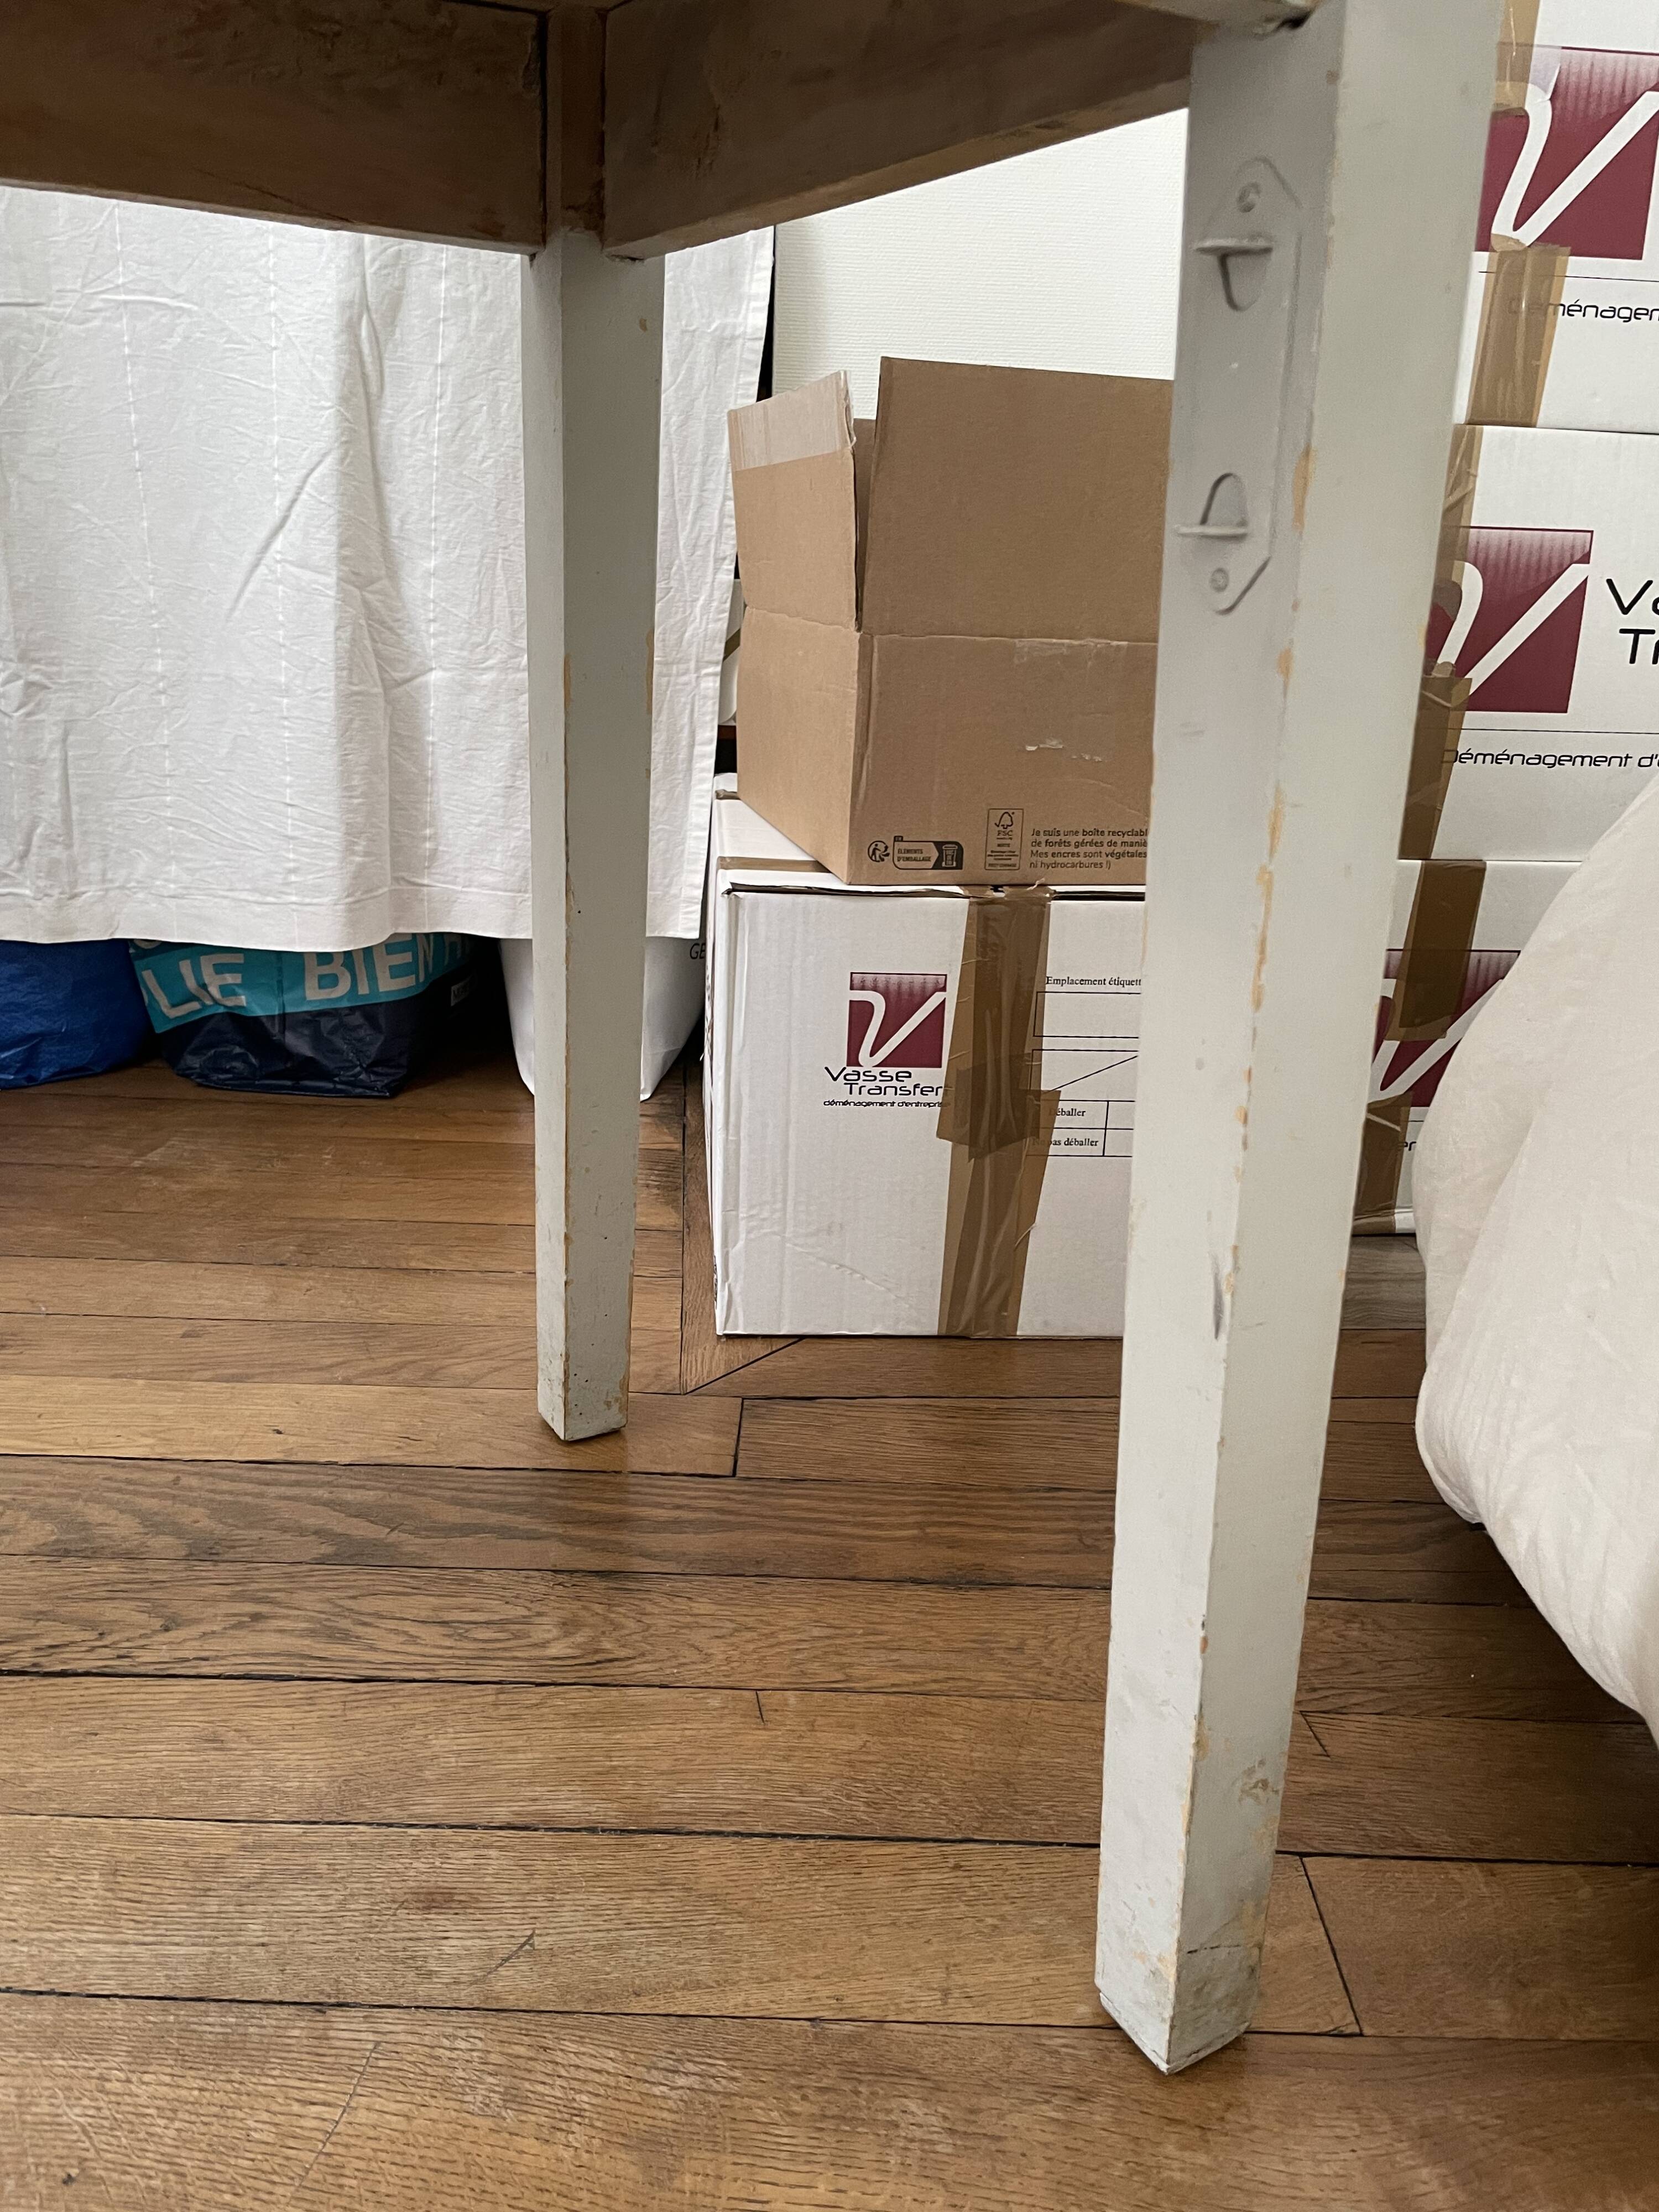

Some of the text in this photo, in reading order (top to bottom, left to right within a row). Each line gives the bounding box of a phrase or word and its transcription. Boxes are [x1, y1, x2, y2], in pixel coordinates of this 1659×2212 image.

[1043, 828, 1061, 837] suis
[1108, 828, 1148, 839] recyclabl
[1031, 839, 1042, 848] de
[1074, 839, 1104, 849] gérées
[1107, 839, 1118, 848] de
[1120, 839, 1148, 848] maniè
[1105, 849, 1147, 859] végétales
[1040, 860, 1103, 869] hydrocarbures
[139, 952, 247, 1019] LIE
[1046, 976, 1141, 988] Emplacement étiquett
[825, 1066, 912, 1082] Vasse
[823, 1099, 896, 1108] déménagement
[1064, 1138, 1099, 1146] déballer
